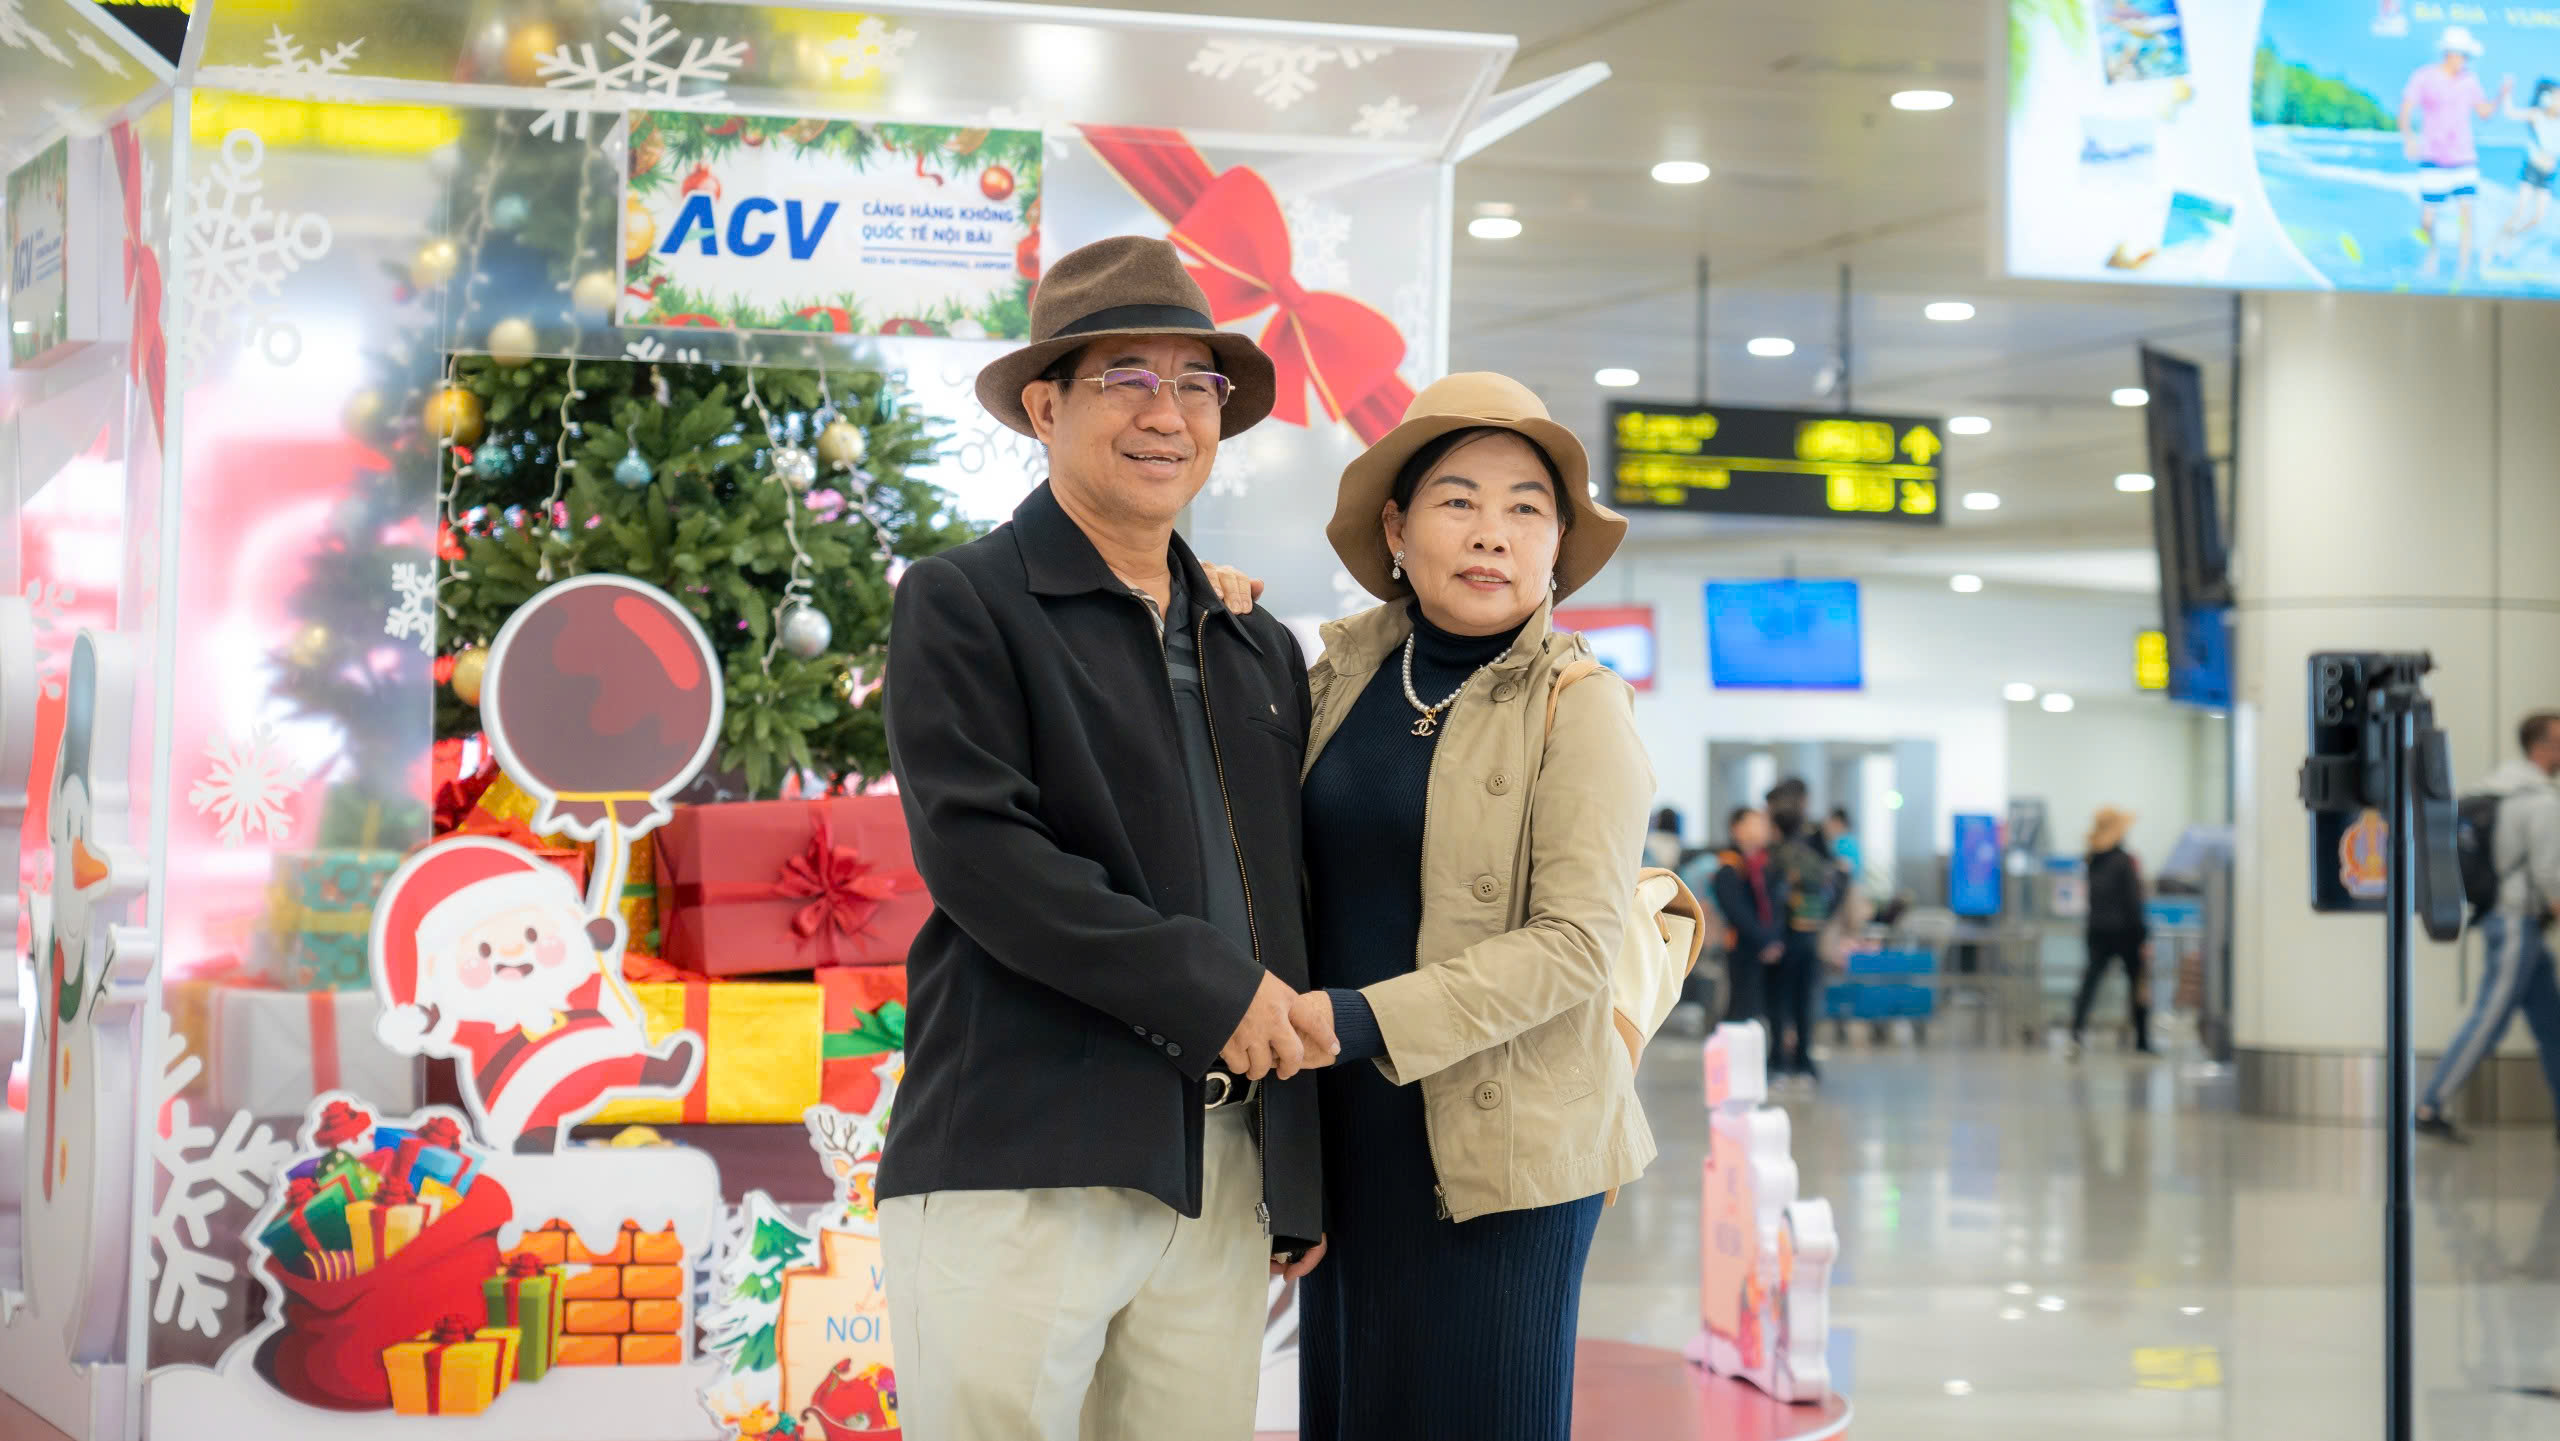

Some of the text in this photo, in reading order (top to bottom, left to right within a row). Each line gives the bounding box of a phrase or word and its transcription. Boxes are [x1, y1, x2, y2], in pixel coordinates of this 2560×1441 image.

[658, 195, 839, 261] ACV
[959, 207, 1014, 223] KHÔNG
[826, 1315, 880, 1344] NOI
